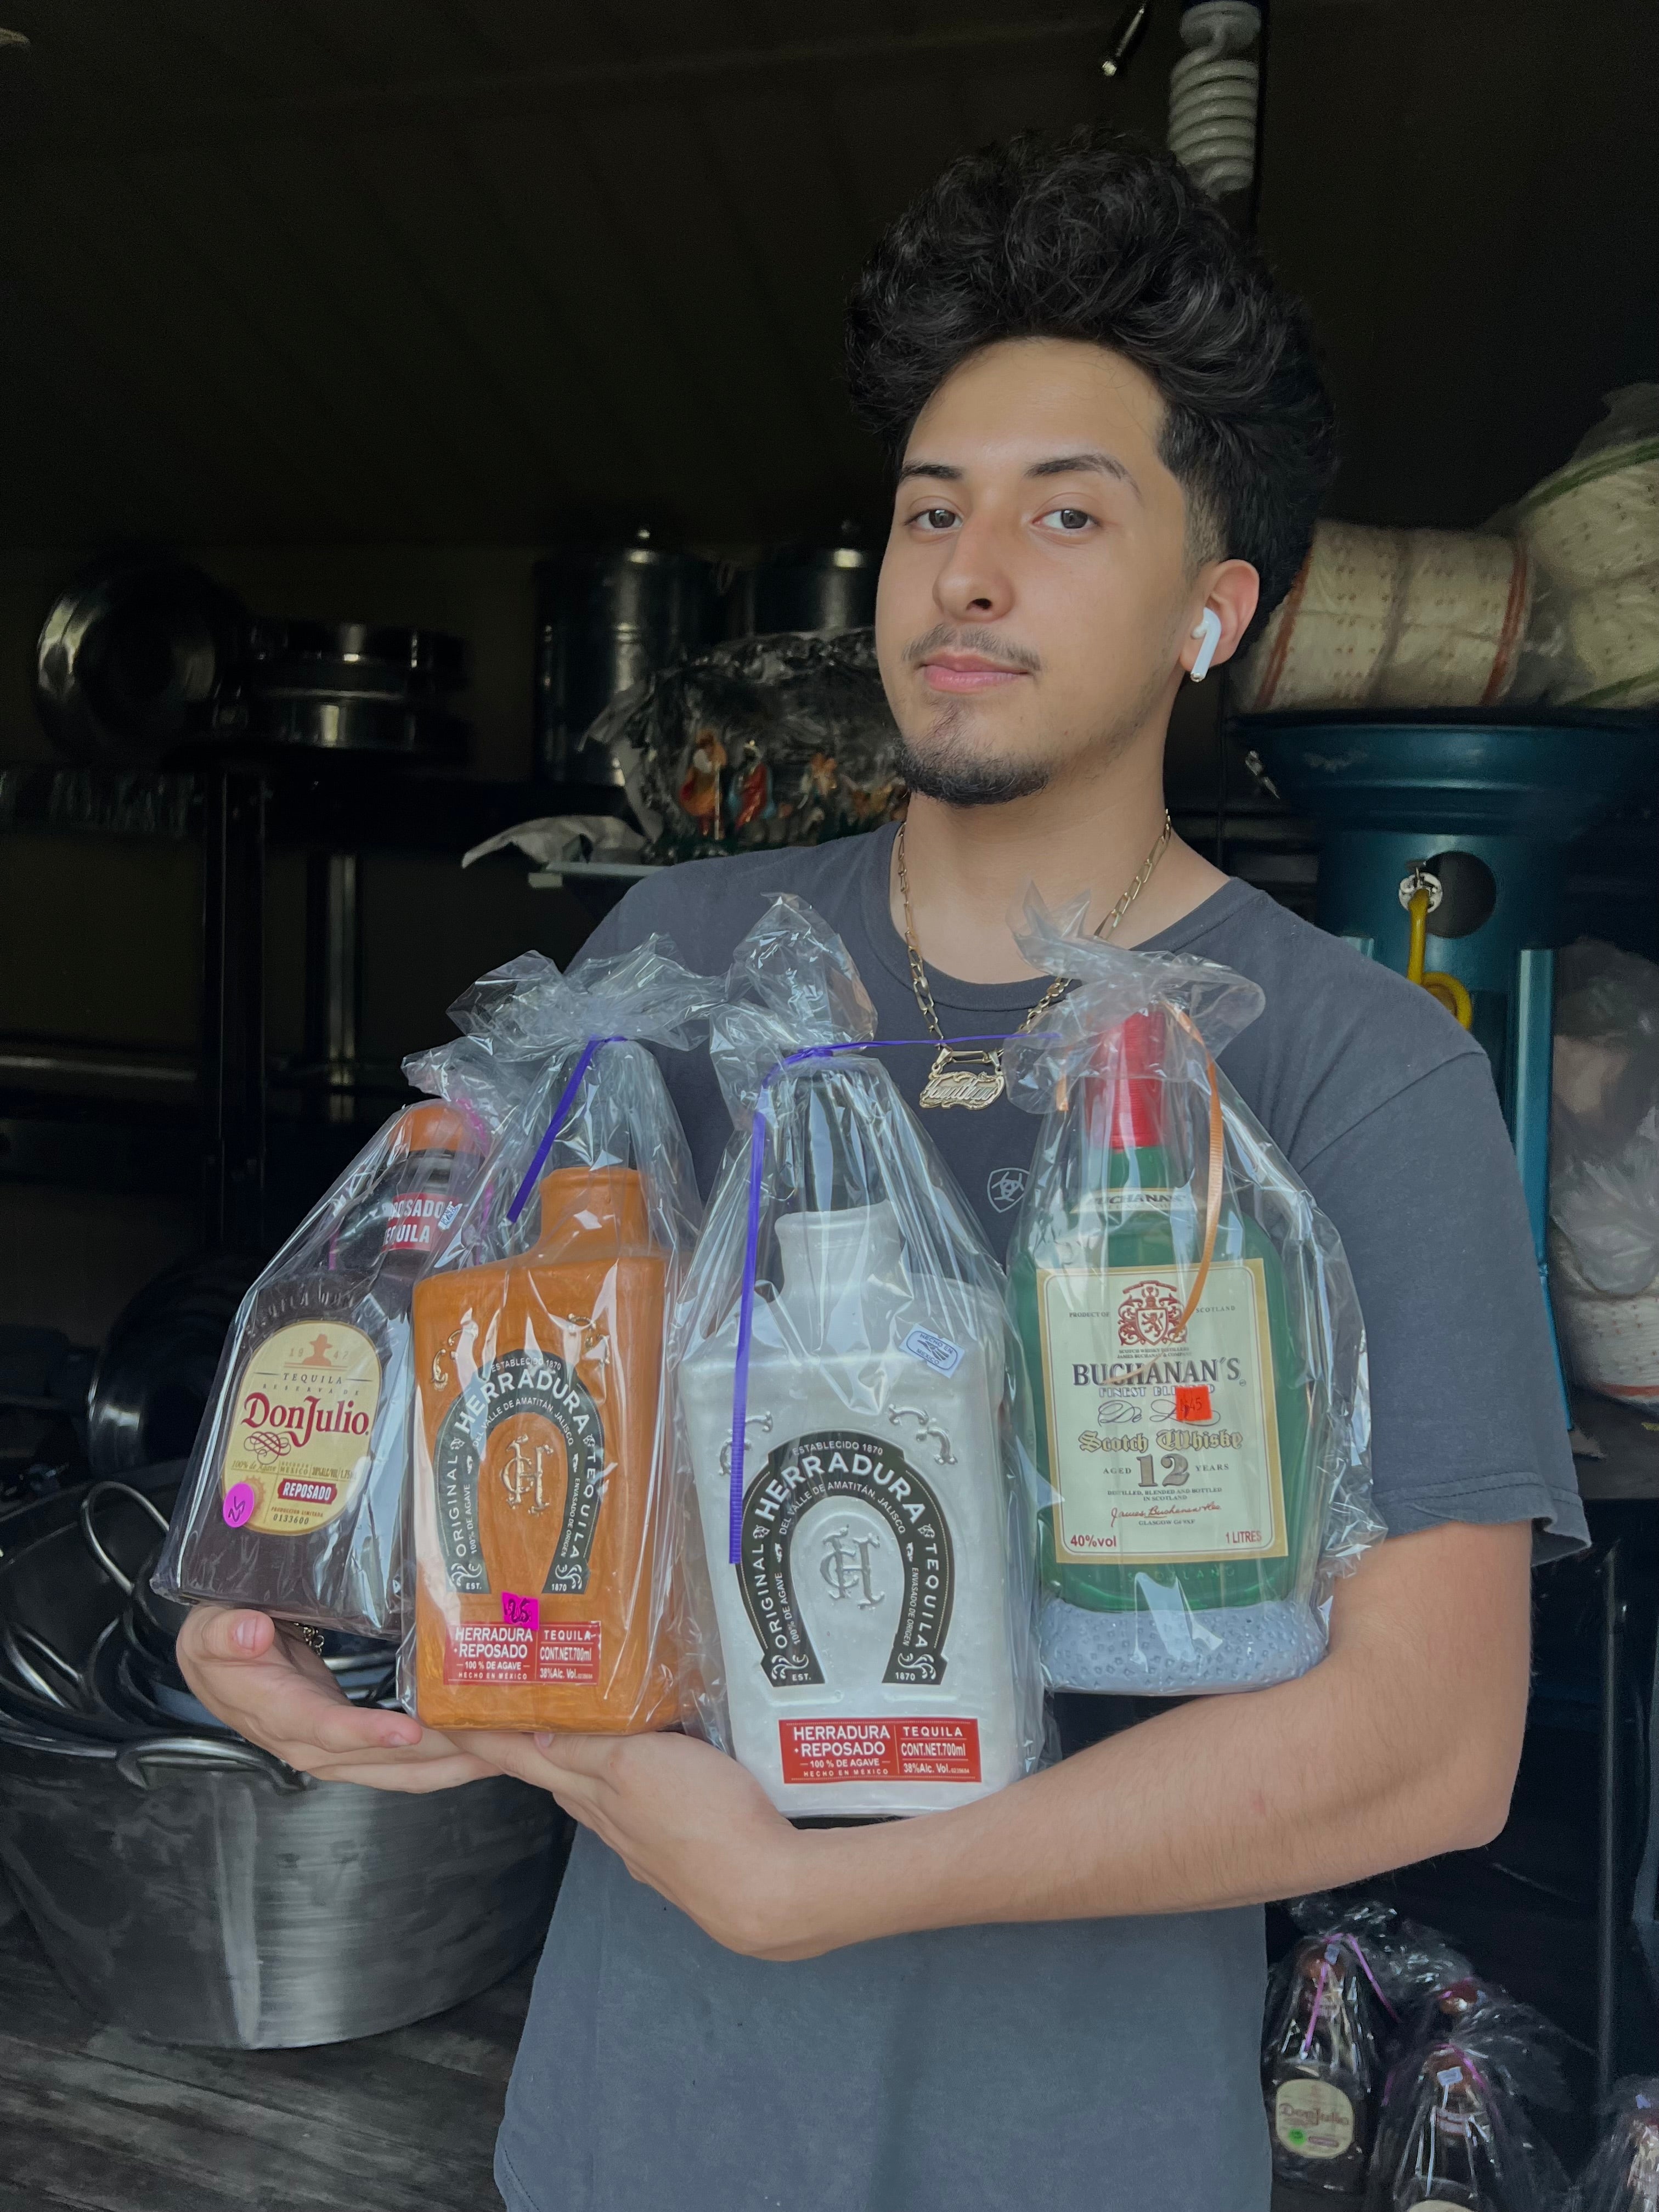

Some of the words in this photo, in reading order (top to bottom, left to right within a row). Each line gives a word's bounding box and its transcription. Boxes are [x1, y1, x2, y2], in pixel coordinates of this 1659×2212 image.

[1195, 1305, 1236, 1313] SCOTLAND
[919, 1333, 944, 1347] HECHO
[944, 1345, 953, 1355] EN
[492, 1357, 543, 1373] ESTABLECIDO
[546, 1359, 562, 1370] 1870
[284, 1373, 342, 1384] TEQUILA
[1099, 1387, 1147, 1398] FINEST
[454, 1369, 591, 1435] HERRADURA
[472, 1430, 485, 1447] DEL
[481, 1408, 503, 1429] VALLE
[504, 1400, 515, 1412] DE
[554, 1411, 574, 1446] JALISCO
[792, 1440, 860, 1455] ESTABLECIDO
[862, 1443, 883, 1456] 1870
[1077, 1429, 1149, 1453] Scotch
[280, 1466, 308, 1475] MEXICO
[1136, 1453, 1190, 1487] 12
[1195, 1463, 1230, 1472] YEARS
[283, 1482, 332, 1502] REPOSADO
[755, 1452, 926, 1524] HERRADURA
[464, 1484, 474, 1515] AGAVE
[569, 1477, 580, 1517] ENVASADO
[447, 1455, 467, 1557] ORIGINAL
[569, 1452, 596, 1559] TEQUILA
[779, 1517, 792, 1536] DEL
[789, 1491, 812, 1516] VALLE
[812, 1483, 826, 1496] DE
[878, 1497, 906, 1534] JALISCO
[273, 1514, 309, 1525] 0133600
[466, 1517, 474, 1530] DE
[567, 1518, 574, 1529] DE
[561, 1529, 572, 1558] ORIGEN
[1232, 1531, 1262, 1544] LITRES
[774, 1572, 788, 1605] AGAVE
[908, 1567, 919, 1607] ENVASADO
[752, 1544, 788, 1649] ORIGINAL
[915, 1543, 939, 1648] TEQUILA
[782, 1606, 793, 1620] DE
[908, 1607, 916, 1618] DE
[455, 1627, 533, 1642] HERRADURA
[544, 1629, 591, 1640] TEQUILA
[787, 1621, 801, 1645] 100%
[902, 1618, 915, 1646] ORIGEN
[459, 1644, 528, 1658] REPOSADO
[465, 1661, 477, 1669] 100
[486, 1661, 495, 1669] DE
[496, 1662, 521, 1670] AGAVE
[792, 1673, 811, 1681] EST.
[895, 1672, 916, 1681] 1870
[793, 1725, 890, 1741] HERRADURA
[903, 1726, 963, 1737] TEQUILA
[802, 1742, 885, 1757] REPOSADO
[810, 1759, 824, 1768] 100
[826, 1759, 834, 1768] %
[836, 1759, 848, 1768] DE
[850, 1758, 880, 1767] AGAVE
